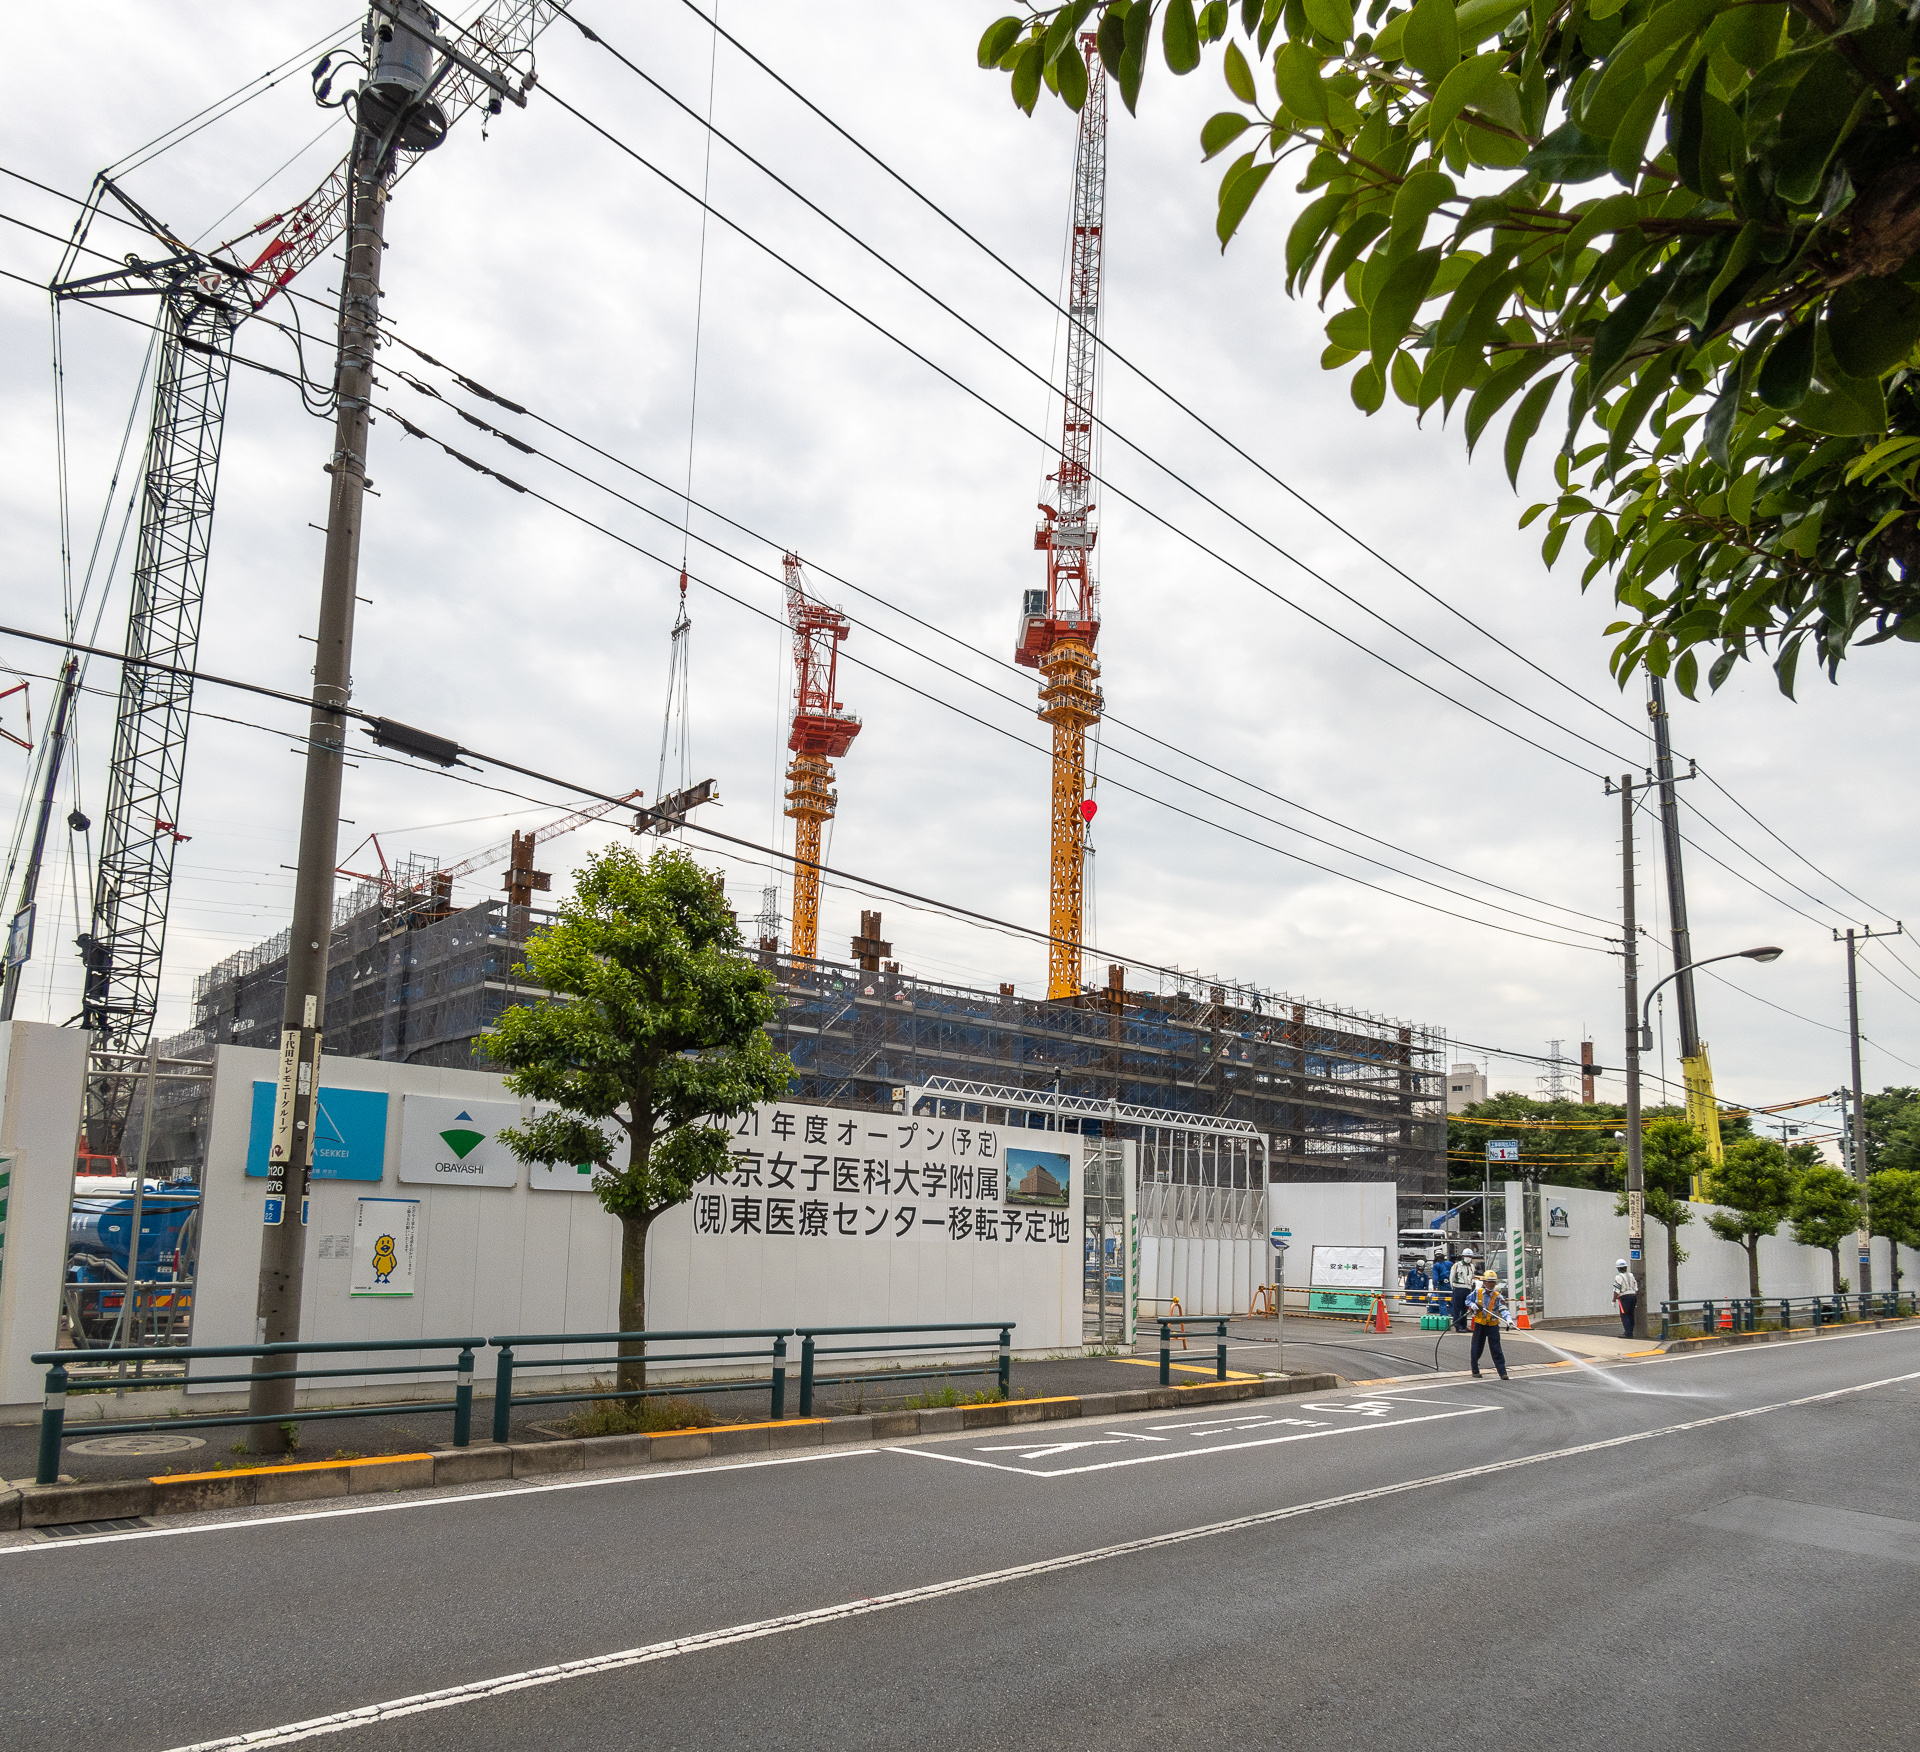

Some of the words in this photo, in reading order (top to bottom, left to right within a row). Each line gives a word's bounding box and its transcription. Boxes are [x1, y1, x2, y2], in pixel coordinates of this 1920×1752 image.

[279, 1031, 296, 1135] 千代田セレモニーグループ
[320, 1148, 349, 1158] SEKKEI
[434, 1162, 484, 1174] OBAYASHI
[693, 1192, 1071, 1244] (現)東医療センター移転予定地
